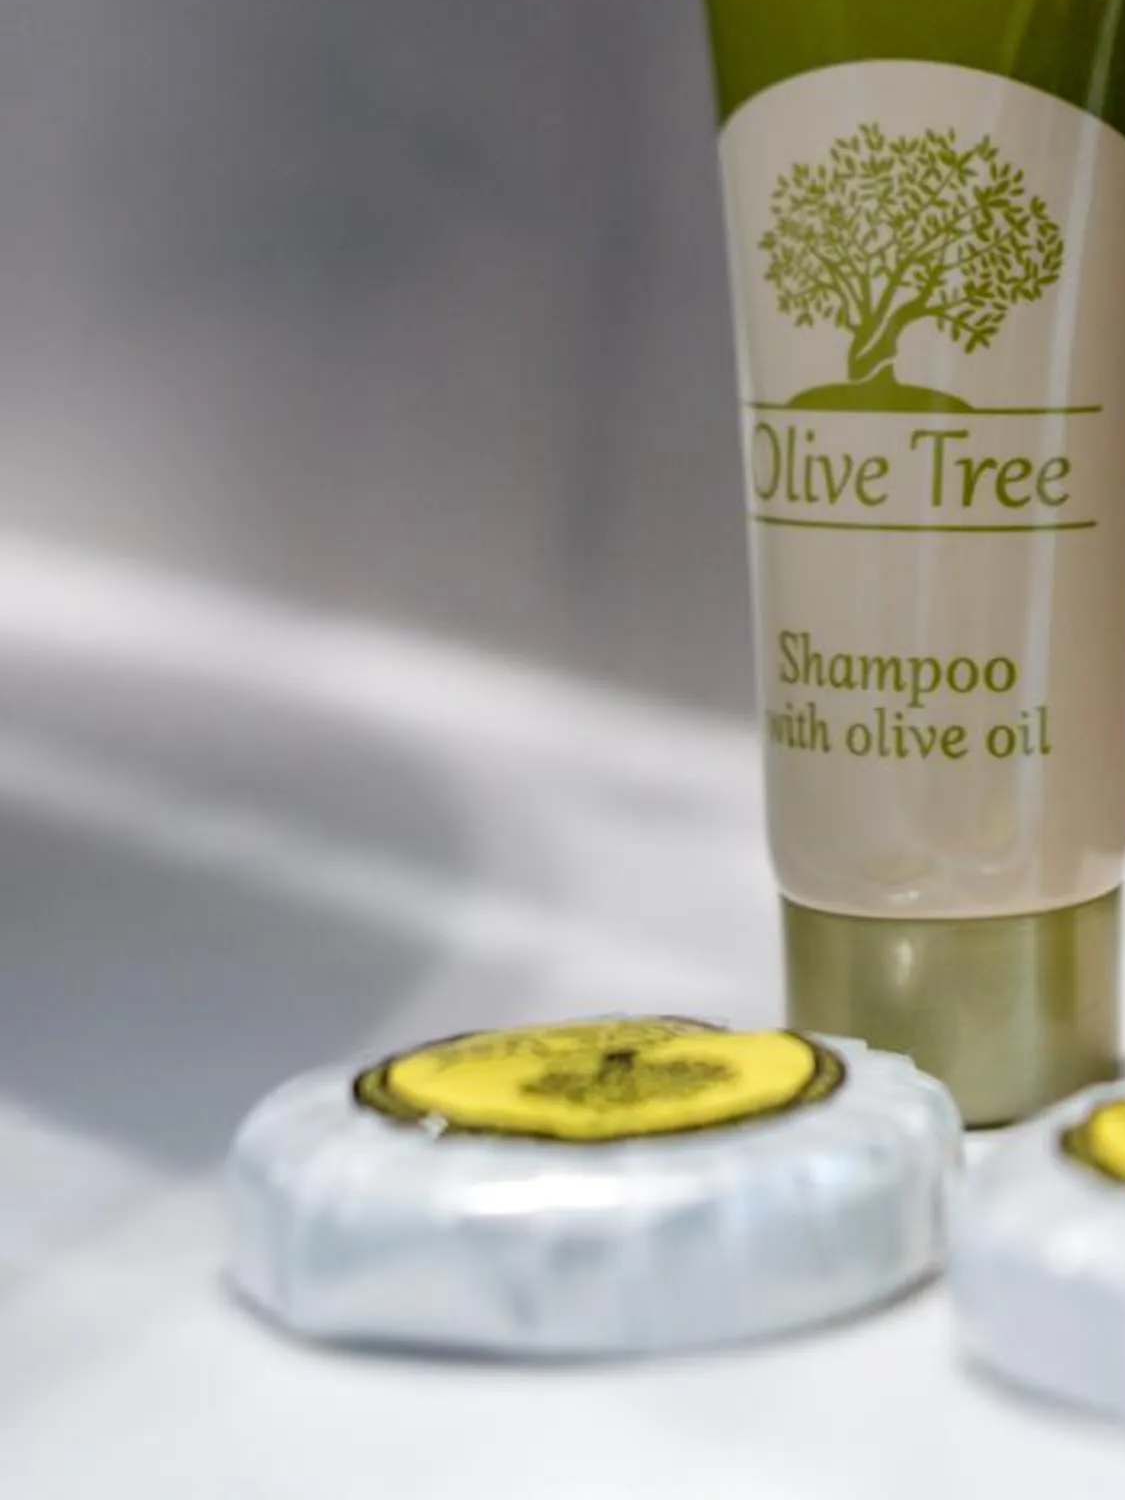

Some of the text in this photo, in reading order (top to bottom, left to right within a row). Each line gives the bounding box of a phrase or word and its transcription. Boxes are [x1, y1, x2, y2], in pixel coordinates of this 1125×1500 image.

[753, 421, 1071, 508] Olive Tree
[778, 630, 1017, 708] Shampoo
[845, 707, 968, 759] olive
[985, 706, 1052, 759] oil
